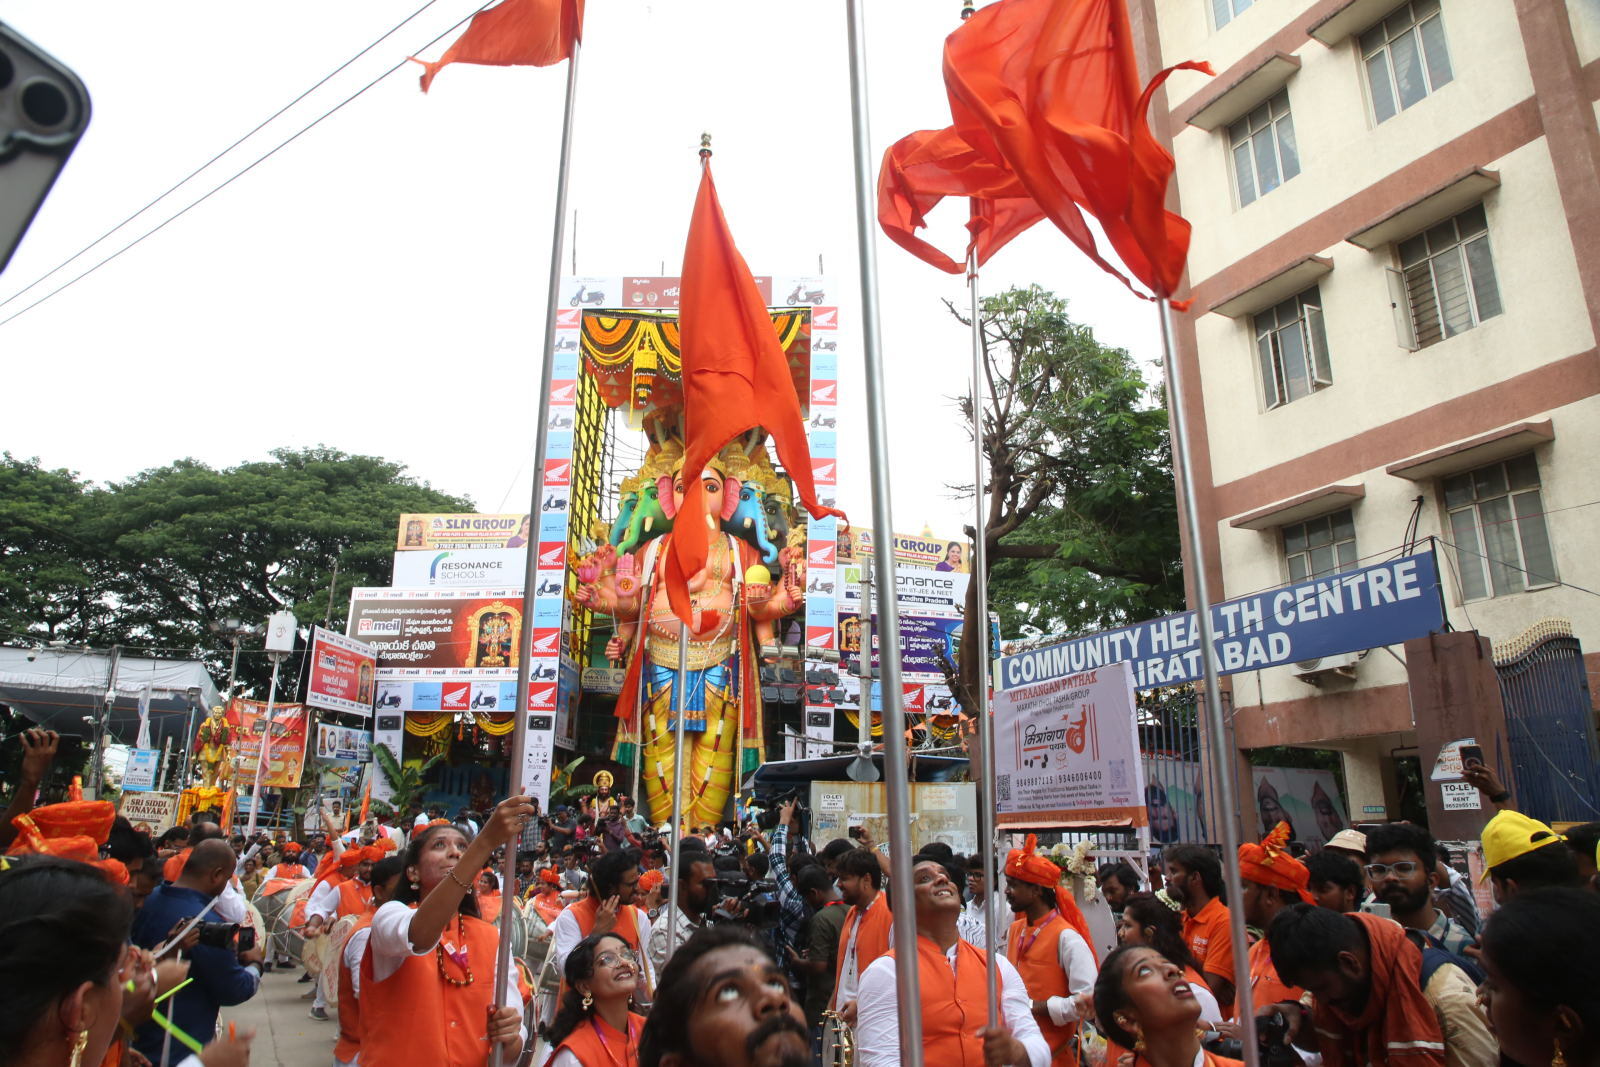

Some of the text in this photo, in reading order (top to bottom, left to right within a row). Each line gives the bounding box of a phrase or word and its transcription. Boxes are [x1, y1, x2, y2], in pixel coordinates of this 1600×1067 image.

[446, 519, 516, 530] SLN GROUP
[900, 539, 942, 554] GROUP
[442, 562, 503, 570] RESONANCE
[441, 571, 486, 580] SCHOOLS
[925, 596, 948, 604] Pradesh
[374, 620, 400, 630] meil
[1008, 560, 1421, 685] COMMUNITY HEALTH CENTRE
[1062, 671, 1098, 690] PATHAK
[1070, 688, 1090, 700] GROUP
[130, 798, 166, 808] SRI SIDDI
[126, 806, 168, 816] VINAYAKA
